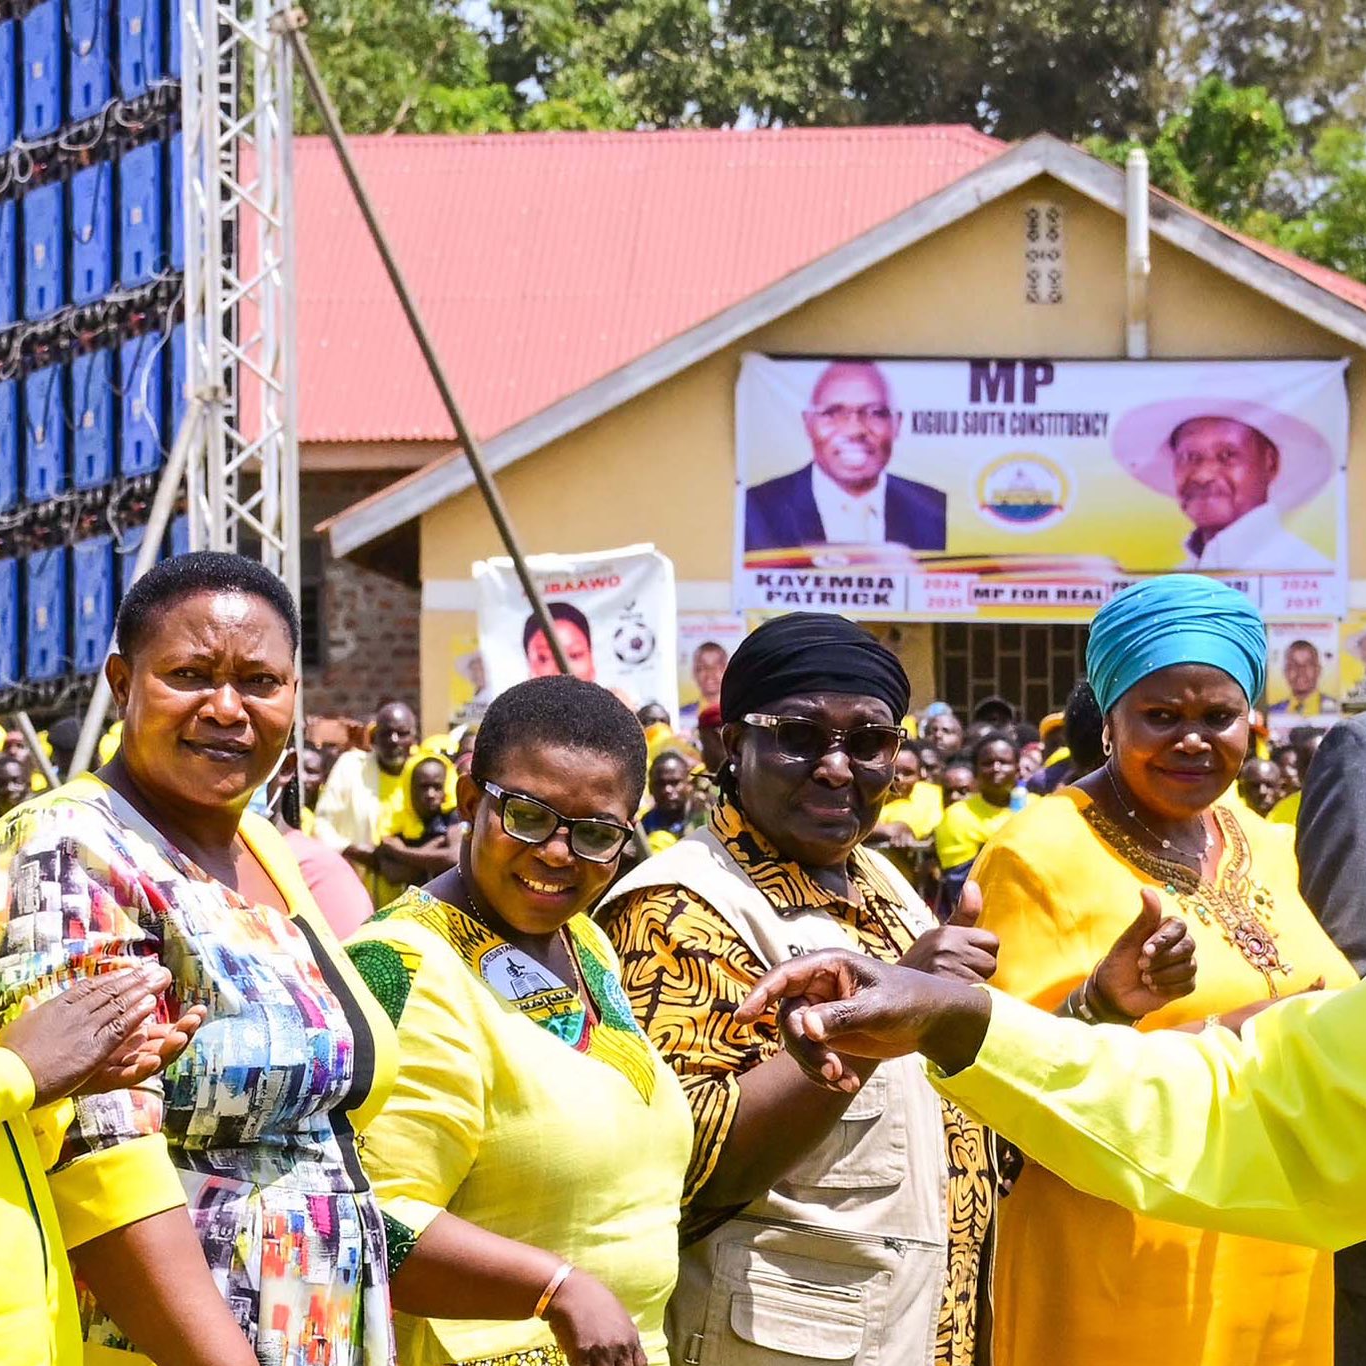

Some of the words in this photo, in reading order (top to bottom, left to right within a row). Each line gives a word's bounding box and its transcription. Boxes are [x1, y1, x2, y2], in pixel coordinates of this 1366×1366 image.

[969, 359, 1054, 404] MP
[911, 411, 958, 435] KIGULU
[963, 411, 1005, 436] SOUTH
[1010, 412, 1109, 437] CONSTITUENCY
[755, 574, 895, 589] KAYEMBA
[766, 590, 890, 605] PATRICK
[973, 587, 1005, 599] MP
[1011, 588, 1049, 600] FOR
[1056, 588, 1102, 600] REAL
